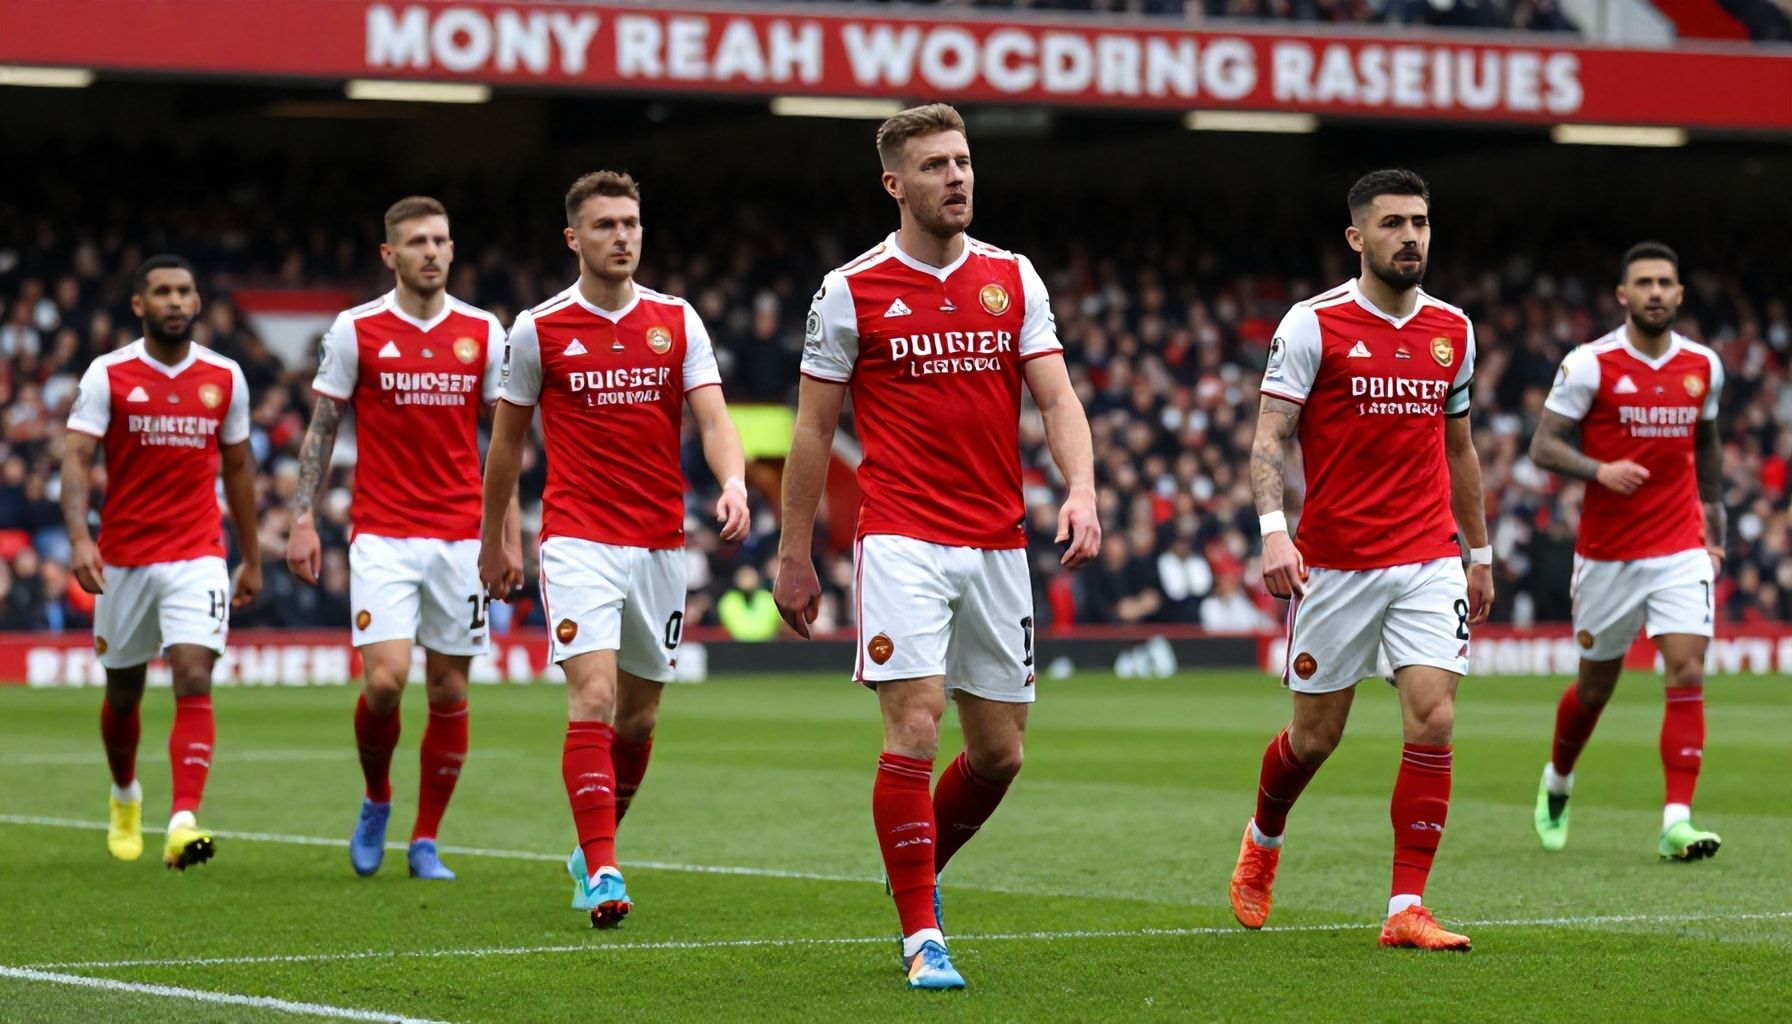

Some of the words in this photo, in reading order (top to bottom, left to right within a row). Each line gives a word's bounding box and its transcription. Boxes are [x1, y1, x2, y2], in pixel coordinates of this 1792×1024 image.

[366, 5, 599, 75] MONY
[615, 15, 823, 83] REAH
[1273, 43, 1583, 113] RASEIUES
[664, 610, 683, 650] 0
[1454, 597, 1469, 641] 8
